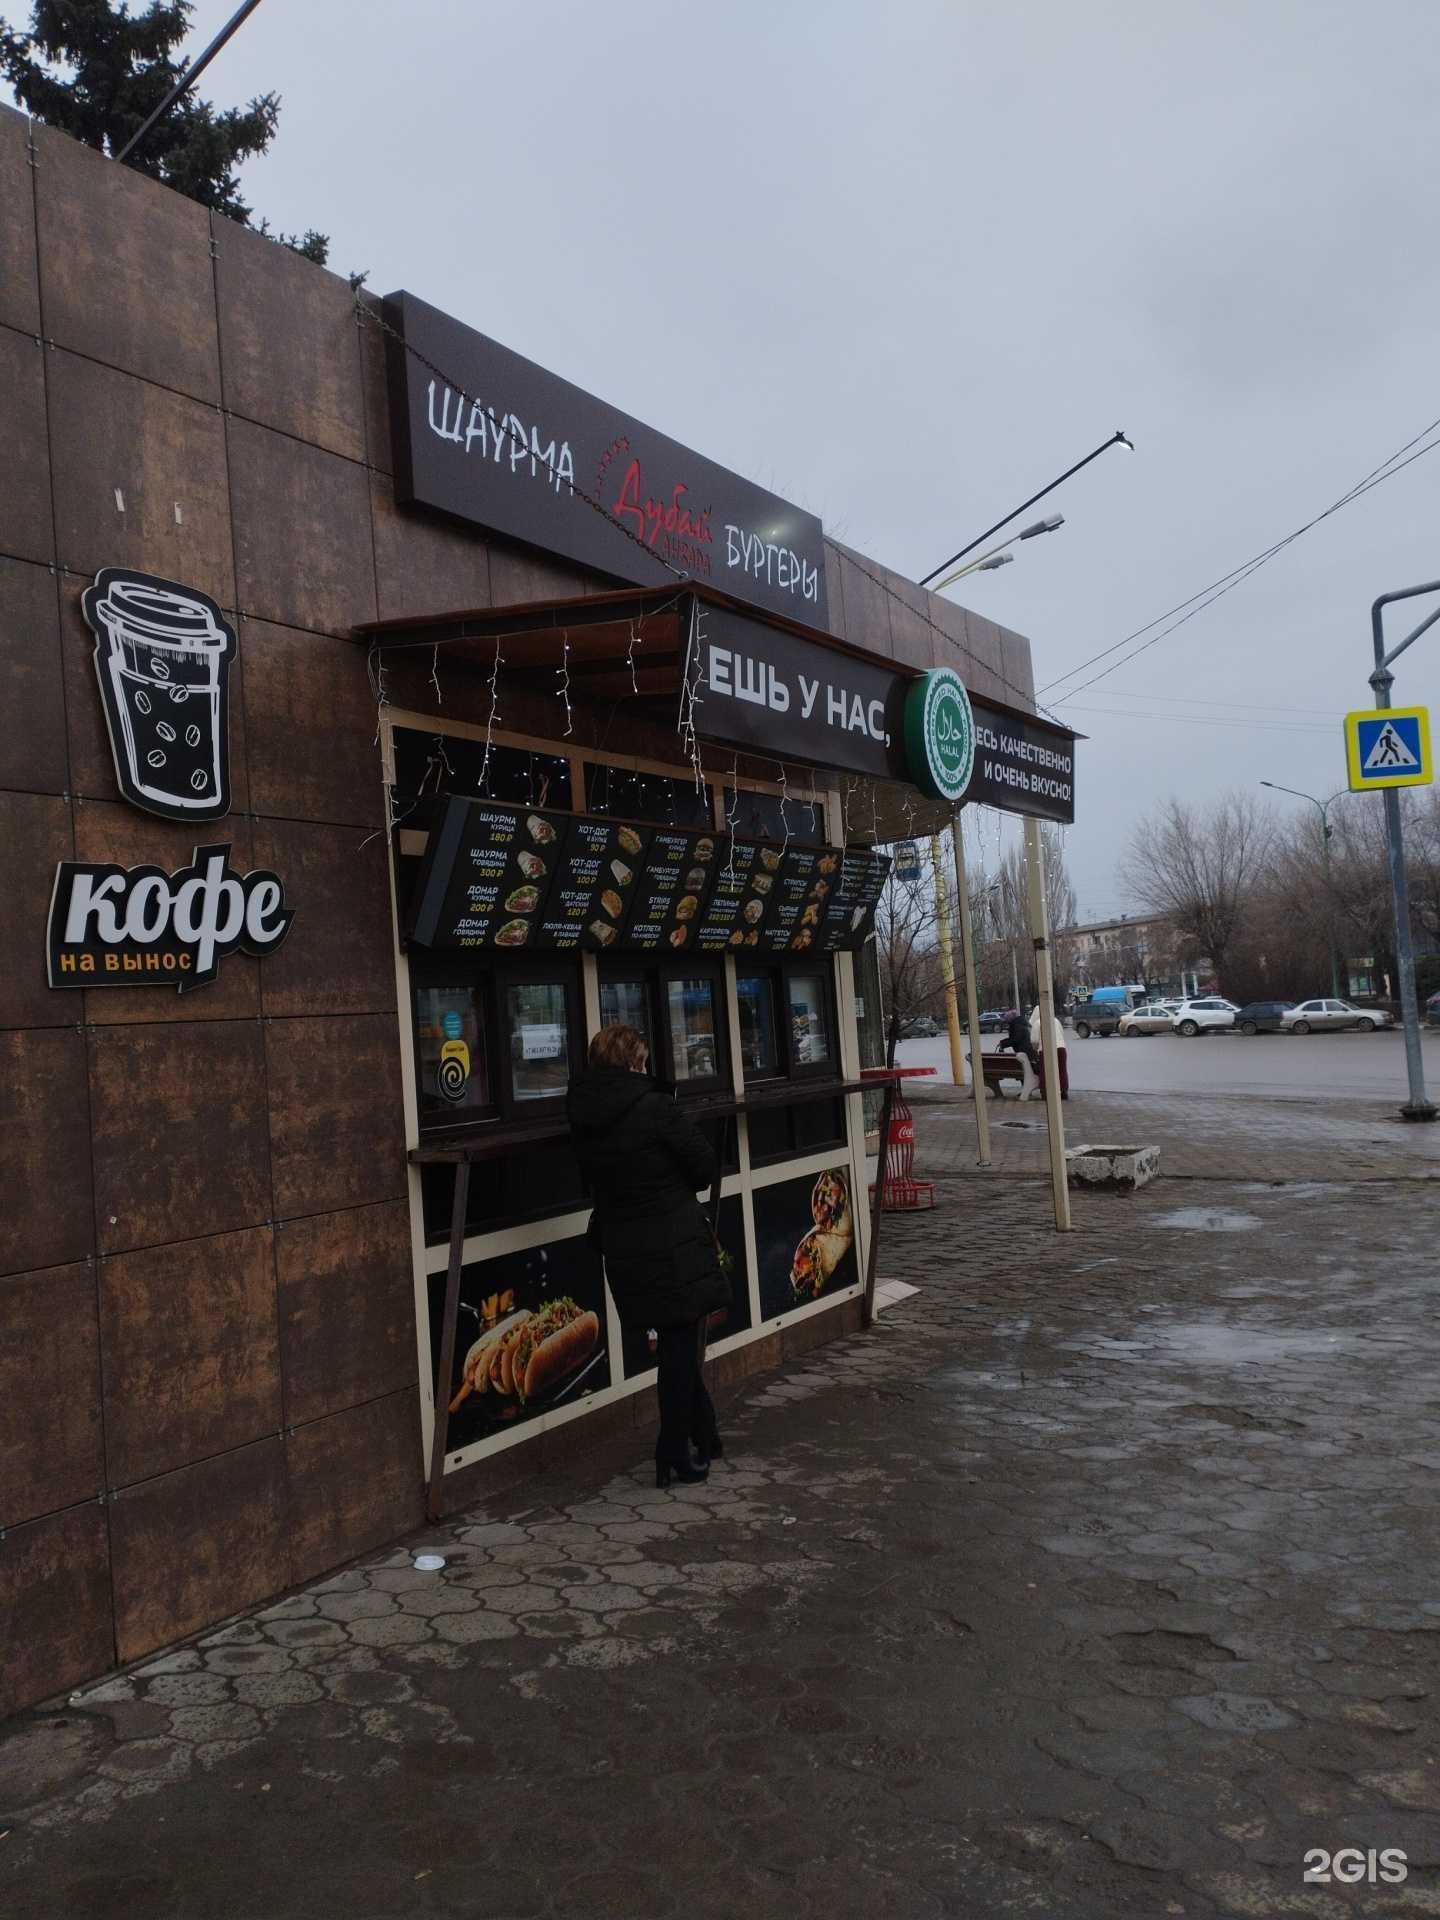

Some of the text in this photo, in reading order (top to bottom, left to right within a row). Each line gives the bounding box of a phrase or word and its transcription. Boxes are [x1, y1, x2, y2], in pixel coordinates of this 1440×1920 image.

[428, 380, 575, 496] ШАУРМА
[612, 458, 713, 545] Дубай
[725, 524, 818, 602] БУРГЕРЫ
[709, 645, 891, 748] ЕШЬ У НАС,
[940, 743, 959, 758] HALAL
[975, 725, 1071, 774] ЕСЬ КАЧЕСТВЕННО
[984, 759, 1071, 802] И ОЧЕНЬ ВКУСНО!
[480, 812, 516, 825] ШАУРМА
[578, 824, 610, 837] ХОТ-ДОГ
[470, 848, 507, 861] ШАУРМА
[569, 857, 602, 869] ХОТ-ДОГ
[467, 885, 499, 896] ДОНАР
[560, 891, 592, 902] ХОТ-ДОГ
[63, 855, 287, 974] кофе
[457, 919, 489, 929] ДОНАР
[60, 951, 192, 973] на вынос
